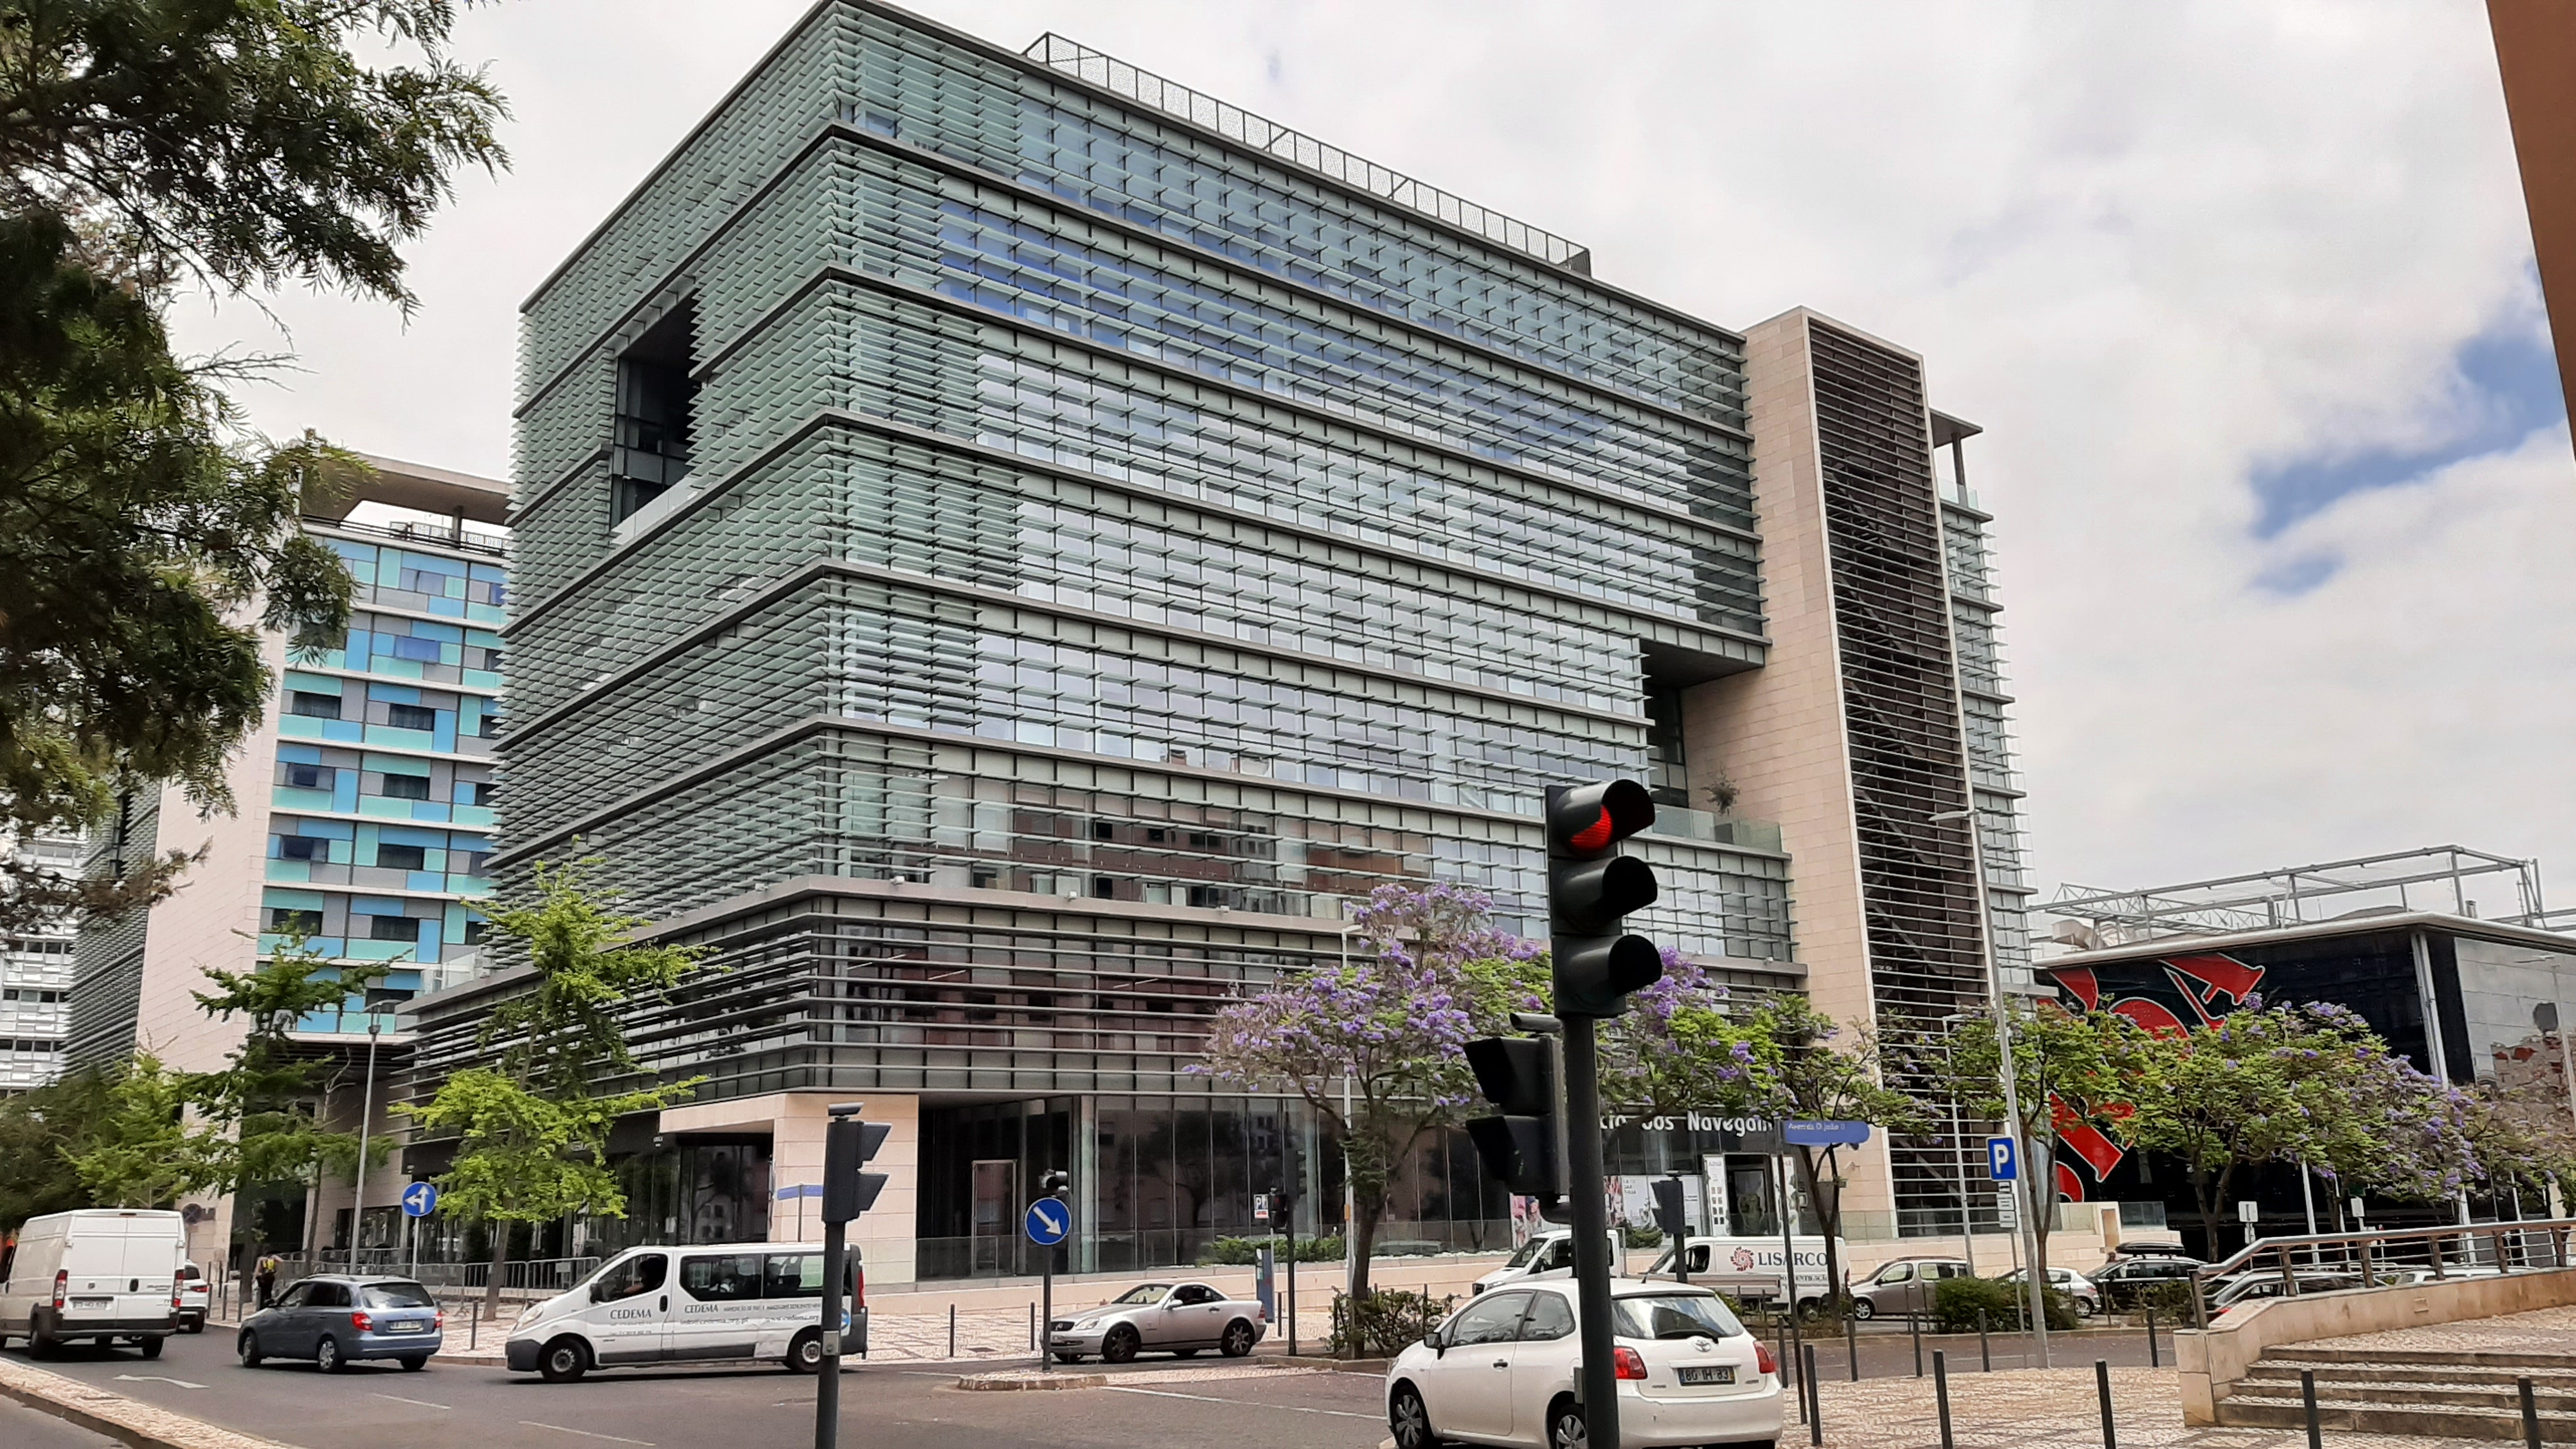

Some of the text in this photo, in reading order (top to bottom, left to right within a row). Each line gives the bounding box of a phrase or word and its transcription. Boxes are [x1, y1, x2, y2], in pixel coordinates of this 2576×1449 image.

[1993, 1144, 2009, 1174] P
[1758, 1252, 1828, 1266] LISRCO
[610, 1309, 652, 1319] CEDEMA
[684, 1304, 719, 1314] CEDEMA
